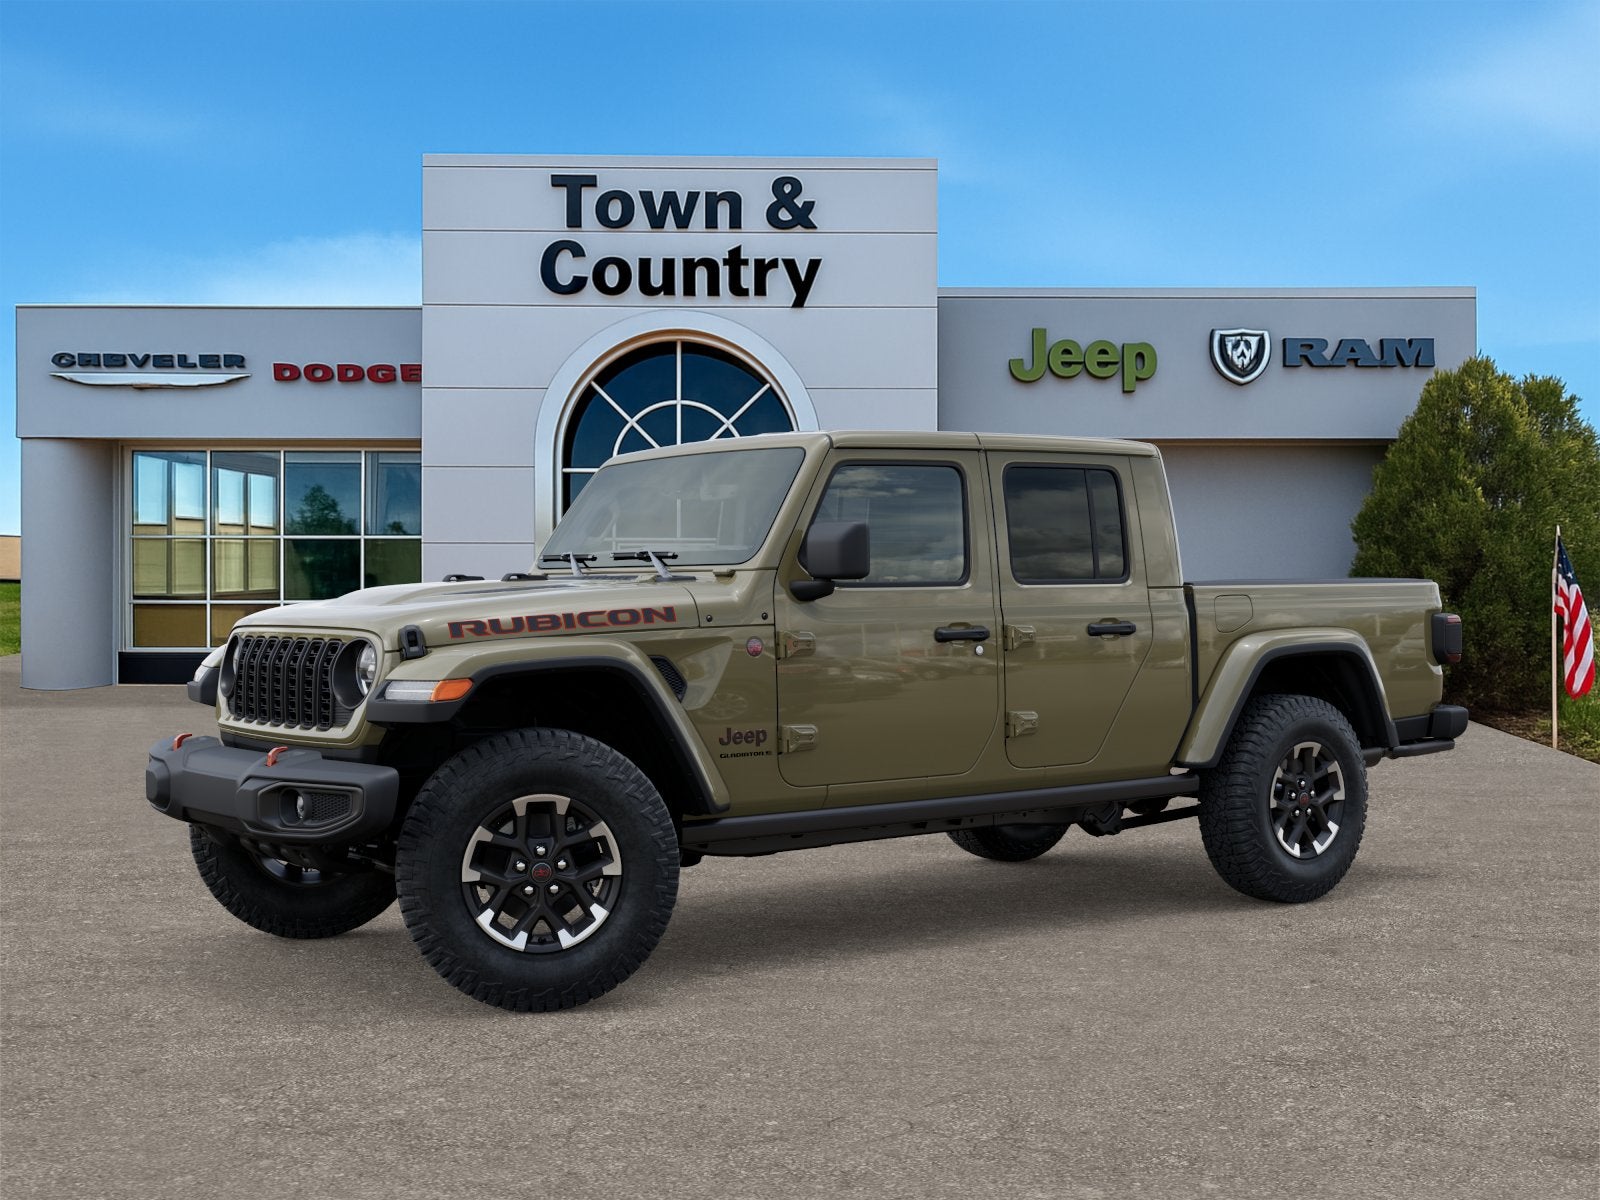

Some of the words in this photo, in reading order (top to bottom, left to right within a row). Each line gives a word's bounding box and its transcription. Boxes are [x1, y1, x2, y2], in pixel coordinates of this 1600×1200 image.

[550, 174, 743, 230] Town
[765, 175, 818, 230] &
[539, 239, 823, 309] Country
[1009, 327, 1158, 393] Jeep
[1282, 337, 1436, 368] RAM
[272, 362, 422, 383] DODGE
[447, 605, 677, 639] RUBICON
[718, 727, 768, 747] Jeep
